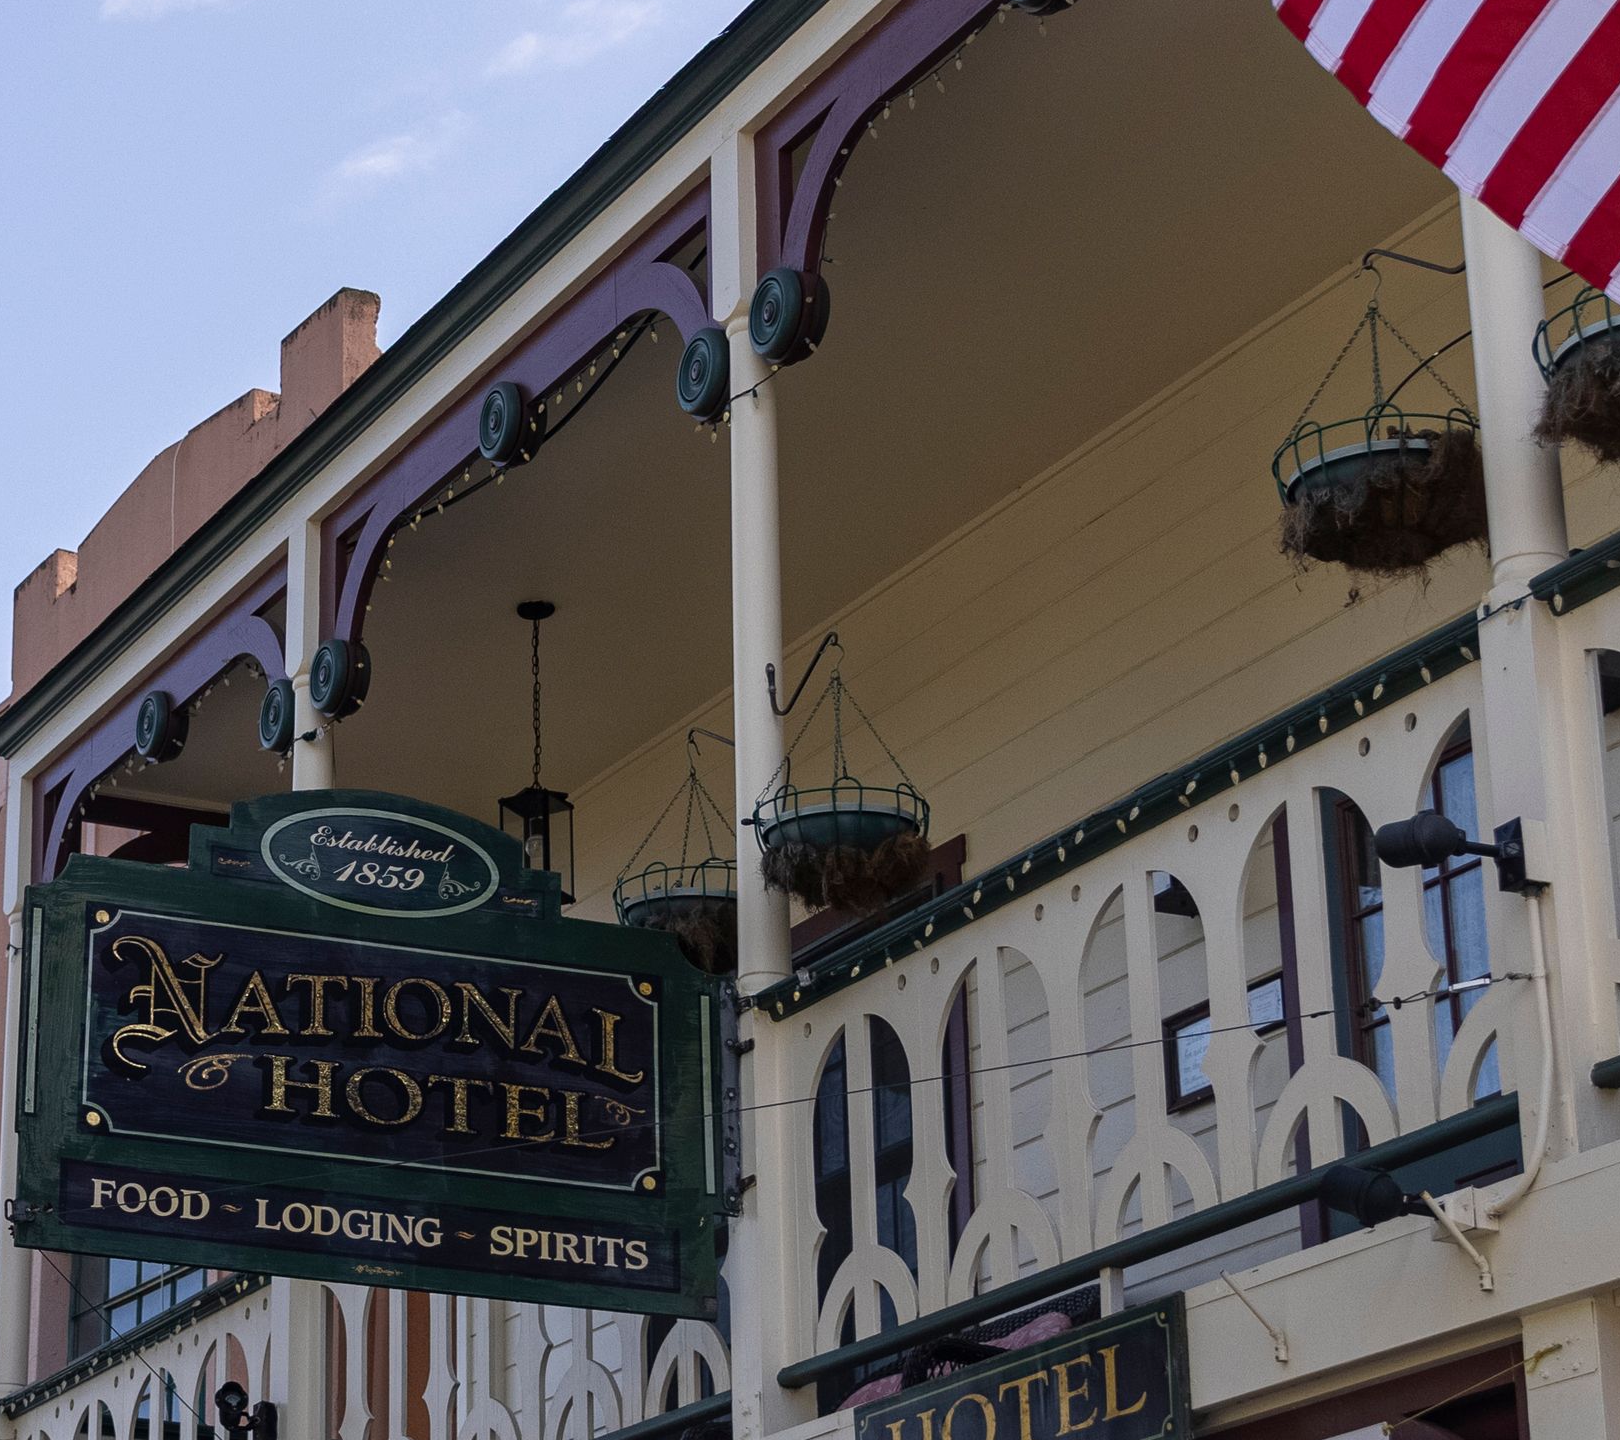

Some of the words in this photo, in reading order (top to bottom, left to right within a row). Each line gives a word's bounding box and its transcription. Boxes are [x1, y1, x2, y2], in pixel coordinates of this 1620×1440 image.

[310, 825, 454, 862] Established
[333, 860, 425, 891] 1859
[264, 1054, 616, 1151] HOTEL
[91, 1178, 211, 1220] FOOD
[256, 1198, 445, 1248] LODGING
[489, 1226, 649, 1270] SPIRITS
